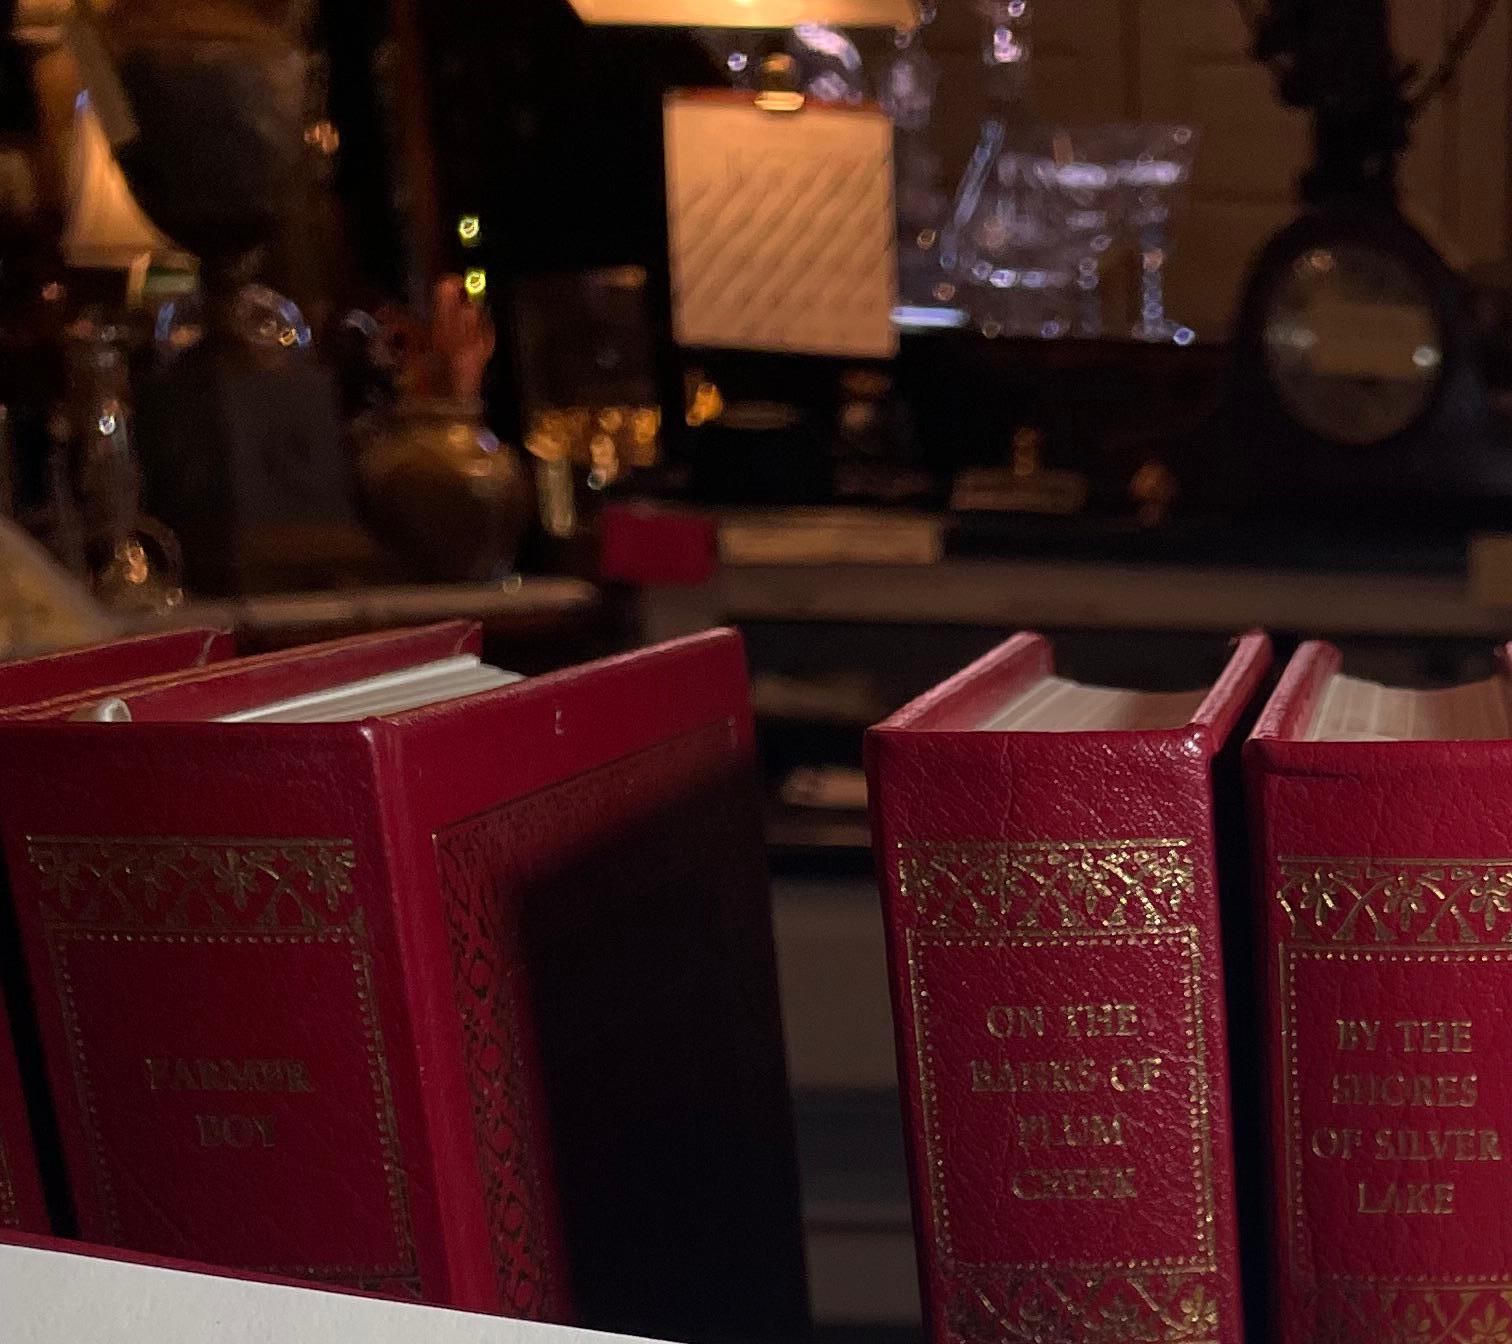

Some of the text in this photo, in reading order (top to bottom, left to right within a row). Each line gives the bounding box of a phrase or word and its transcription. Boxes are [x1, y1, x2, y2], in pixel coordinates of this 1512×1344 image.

[987, 1003, 1139, 1038] ON THE
[1336, 1019, 1473, 1052] BY THE
[1110, 1057, 1163, 1092] OF
[1332, 1074, 1478, 1107] SHORES
[1312, 1127, 1502, 1161] OF SILVER
[1357, 1183, 1455, 1214] LAKE
